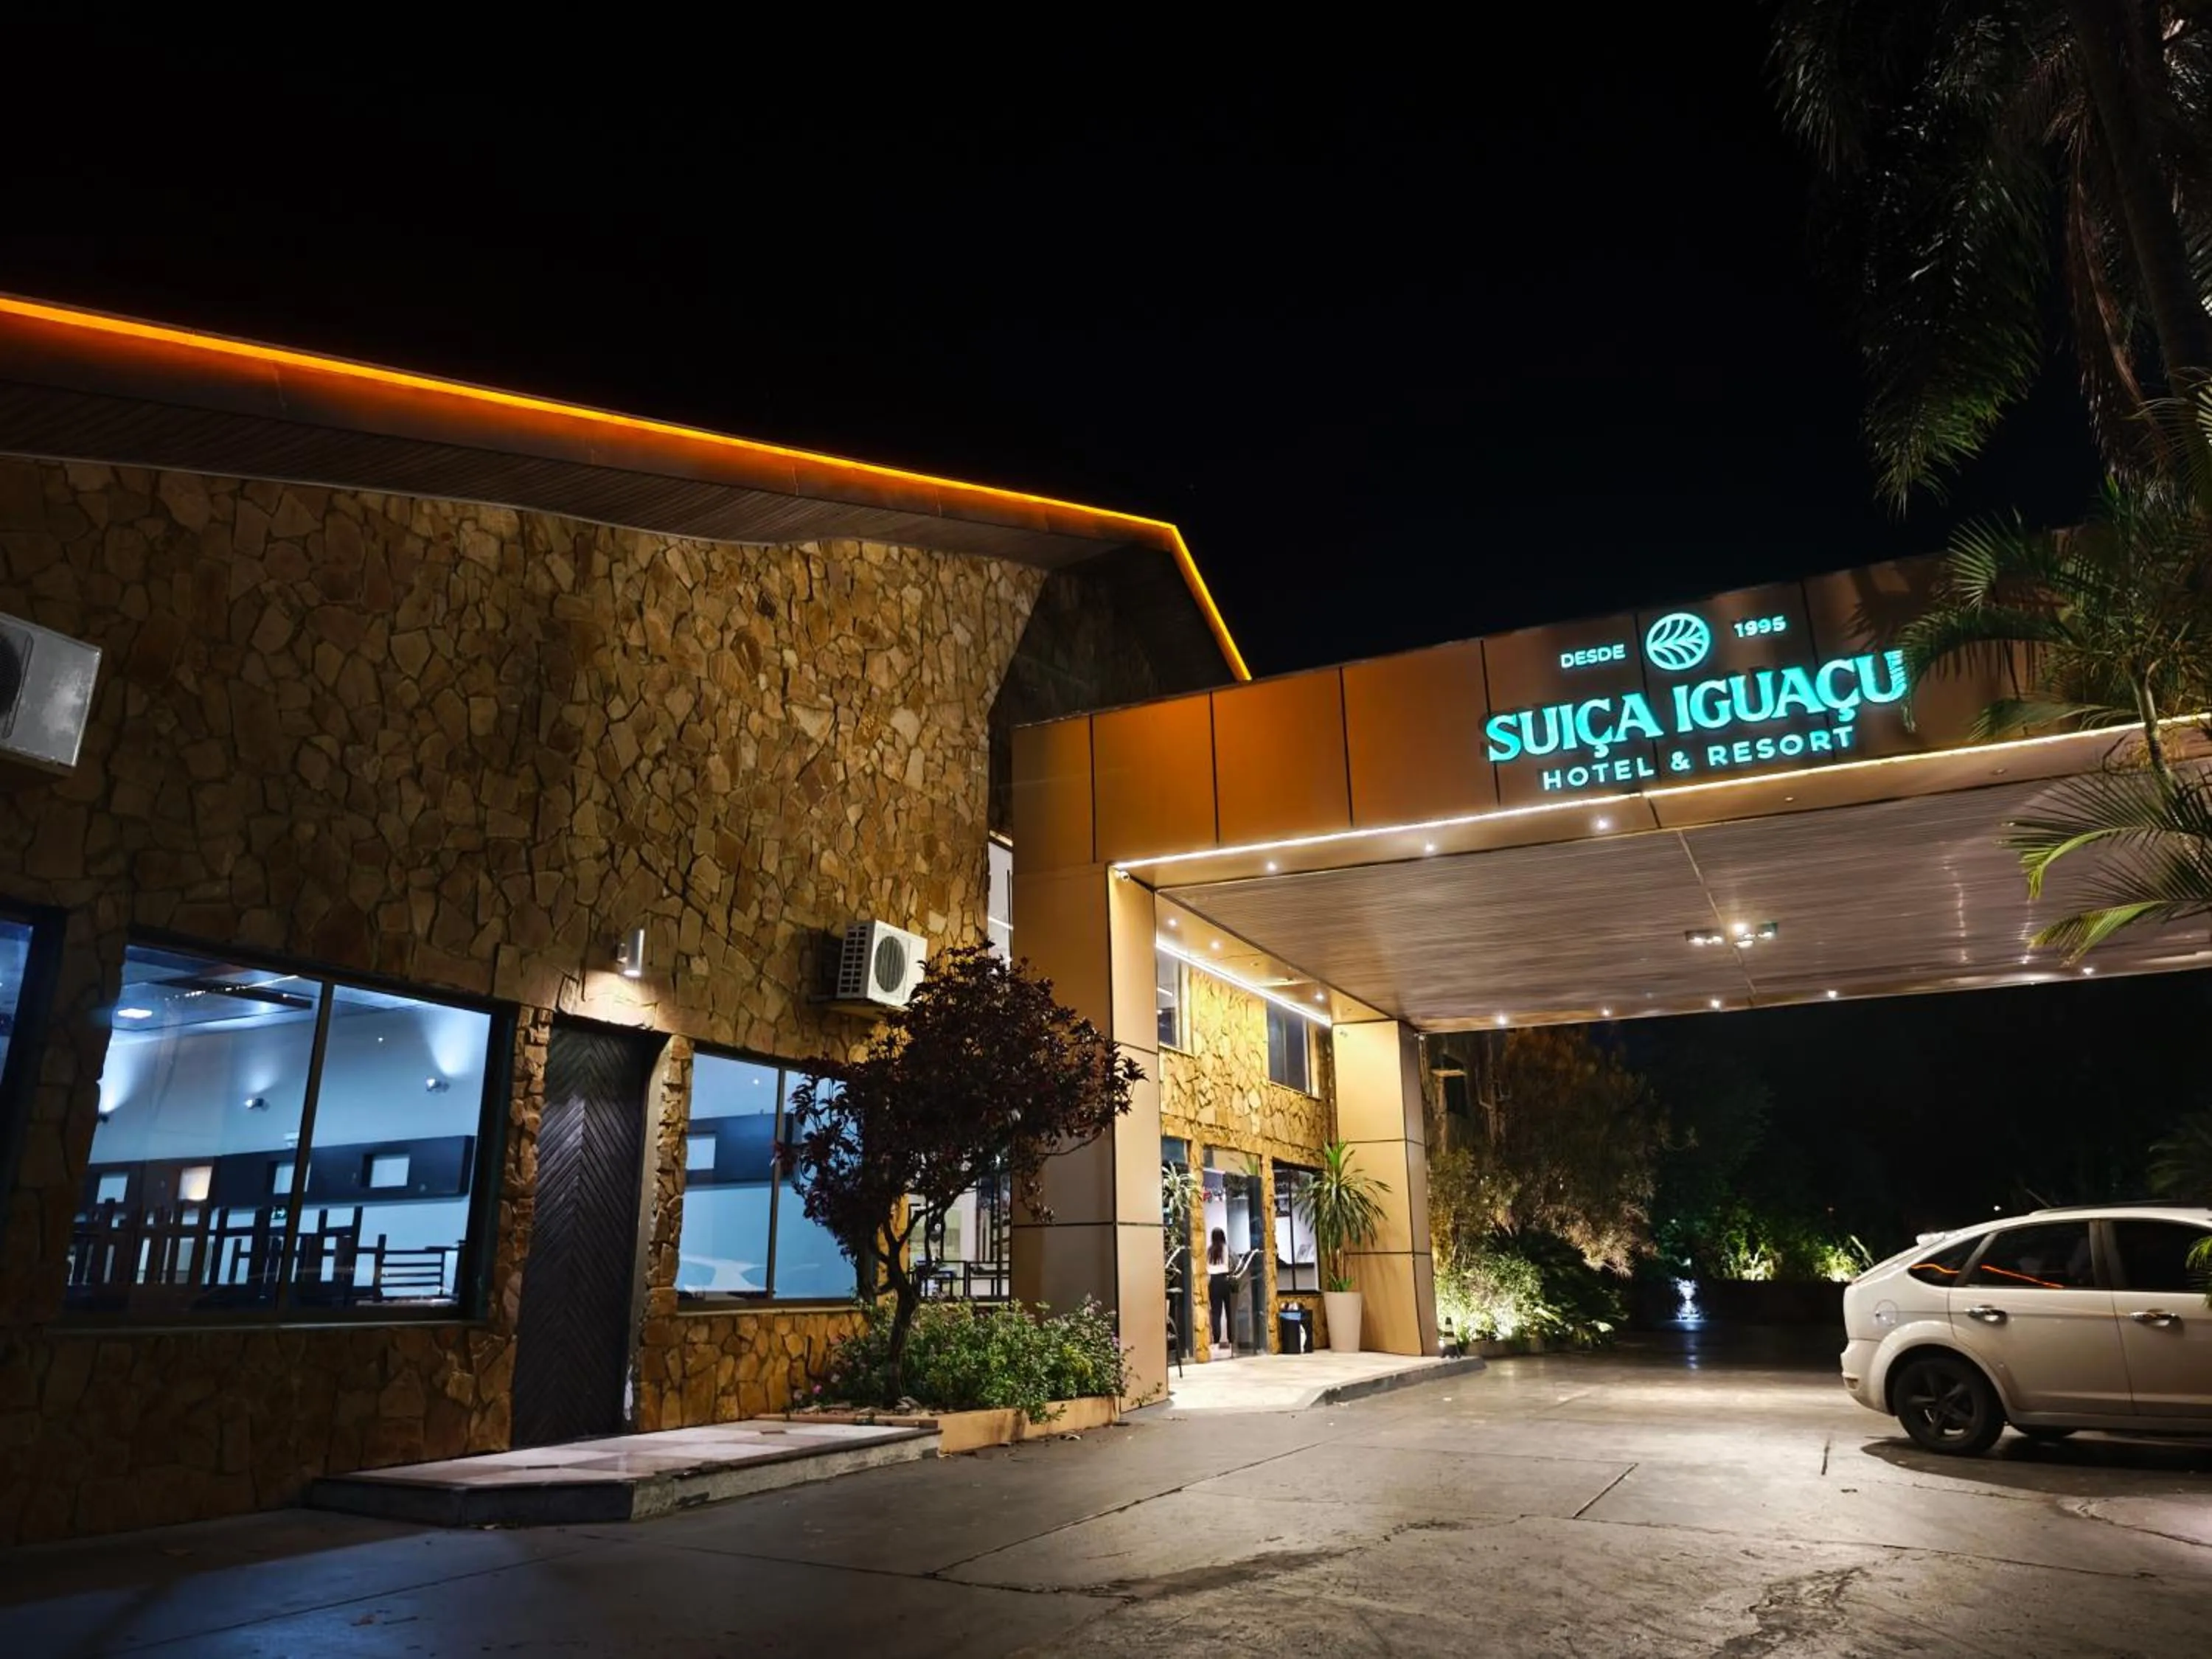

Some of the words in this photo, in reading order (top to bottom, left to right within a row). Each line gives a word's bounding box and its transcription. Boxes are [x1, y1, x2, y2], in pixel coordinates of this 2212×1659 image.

[1559, 643, 1627, 669] DESDE
[1733, 615, 1787, 638] 1995
[1485, 692, 1664, 762] SUIÇA
[1672, 650, 1908, 733] IGUAÇU
[1543, 757, 1655, 790] HOTEL
[1670, 751, 1691, 772] &
[1706, 726, 1854, 767] RESORT
